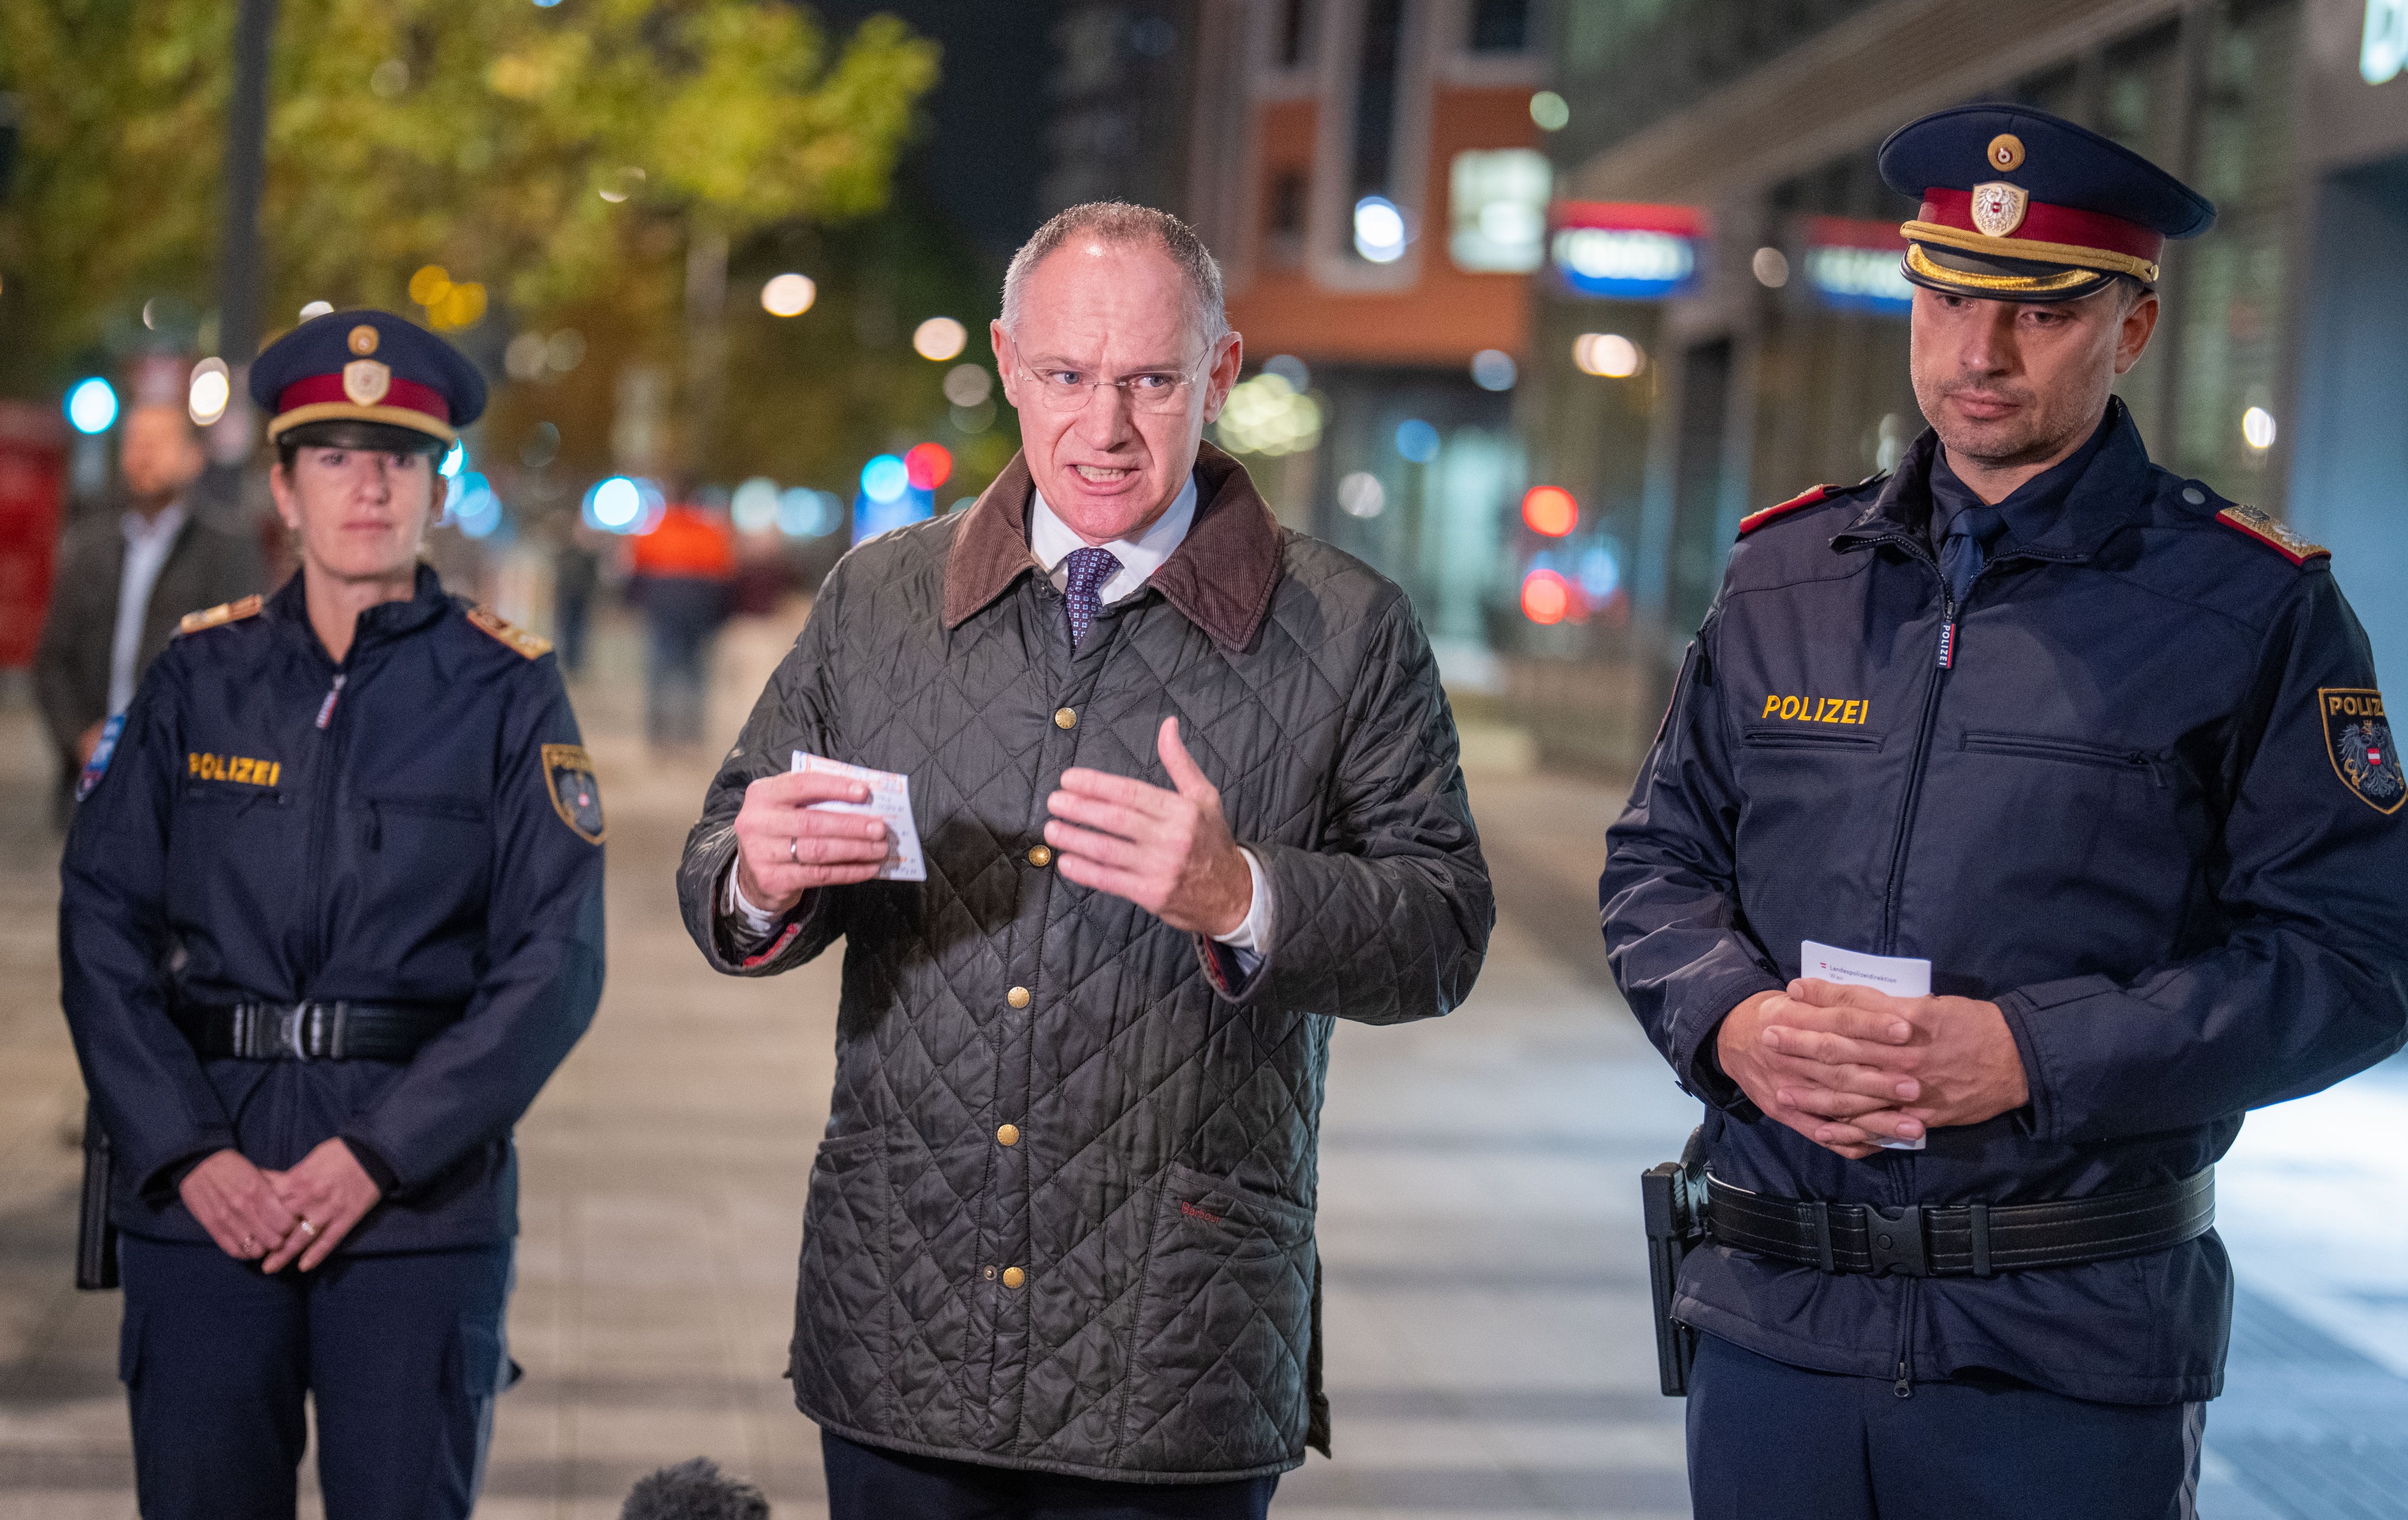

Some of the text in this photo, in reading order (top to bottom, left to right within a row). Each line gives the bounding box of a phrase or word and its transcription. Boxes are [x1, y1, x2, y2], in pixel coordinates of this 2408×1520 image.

[1938, 624, 1951, 666] POLIZEI
[1761, 694, 1869, 724] POLIZEI
[188, 752, 280, 787] POLIZEI
[1830, 965, 1897, 983] Landespolizeidirektion
[1830, 973, 1844, 981] Wien
[1181, 1201, 1220, 1224] Barbour
